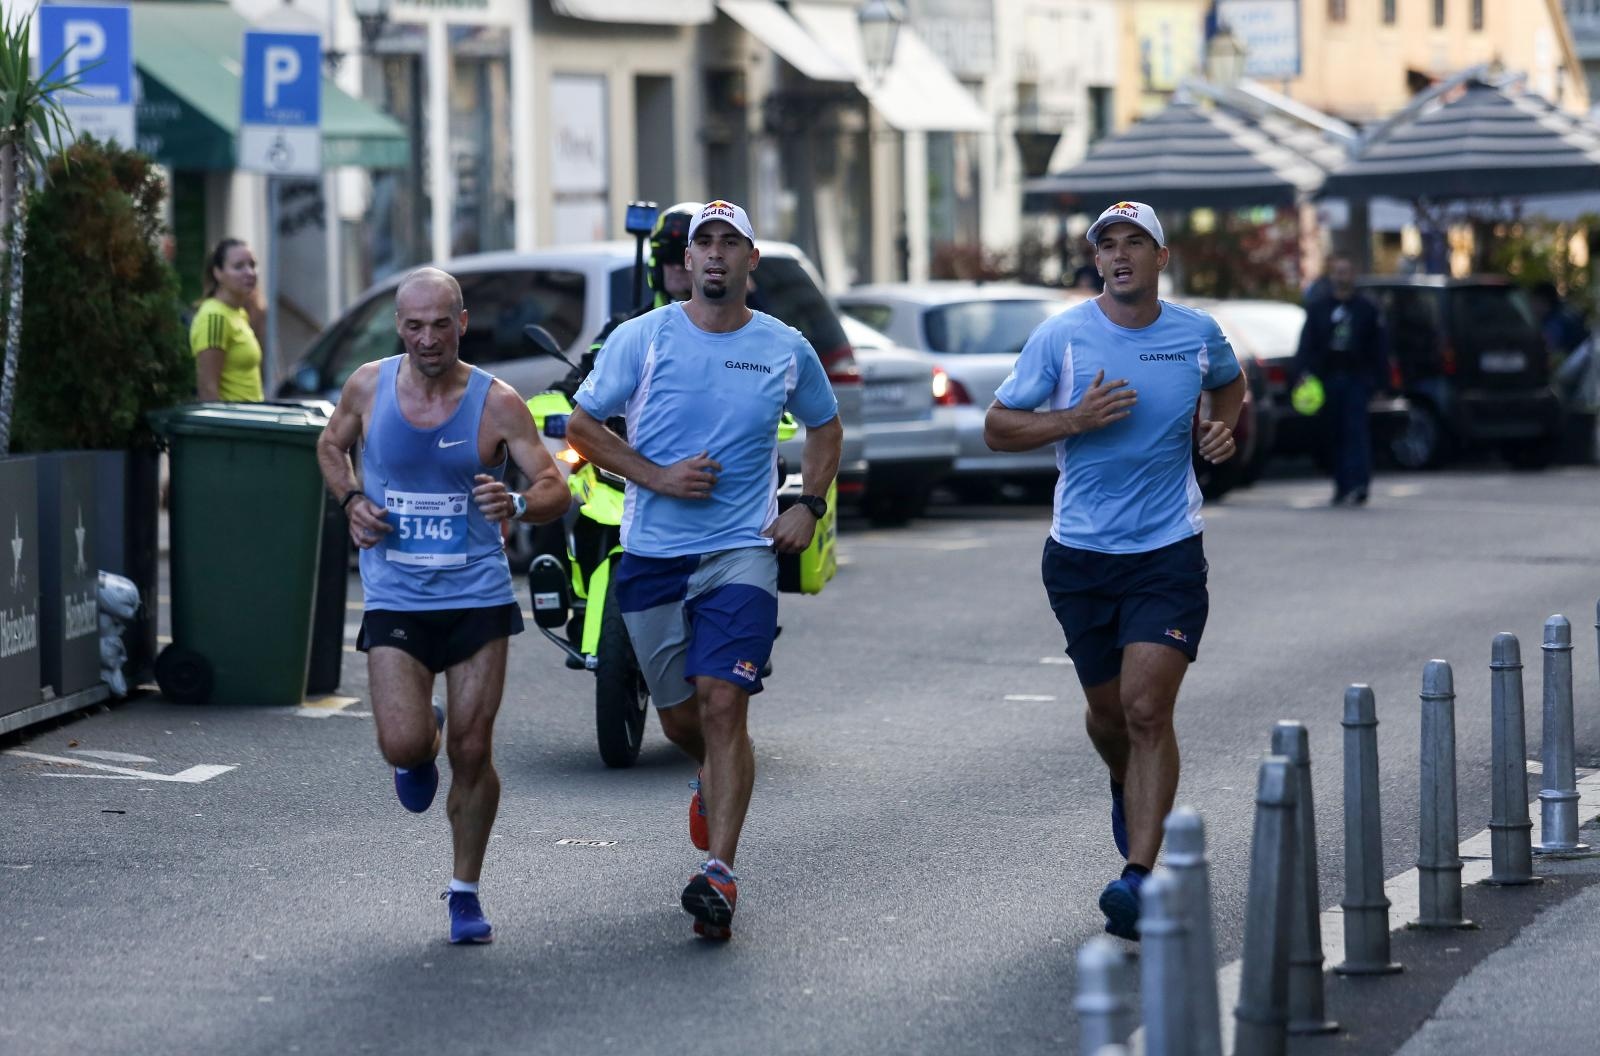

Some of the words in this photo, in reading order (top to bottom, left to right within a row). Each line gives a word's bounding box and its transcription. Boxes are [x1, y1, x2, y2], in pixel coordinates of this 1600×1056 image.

[64, 20, 107, 84] P
[263, 46, 302, 109] P
[701, 209, 717, 219] Red
[718, 209, 735, 219] Bull
[724, 360, 772, 375] GARMIN
[1139, 353, 1186, 362] GARMIN
[399, 516, 453, 541] 5146
